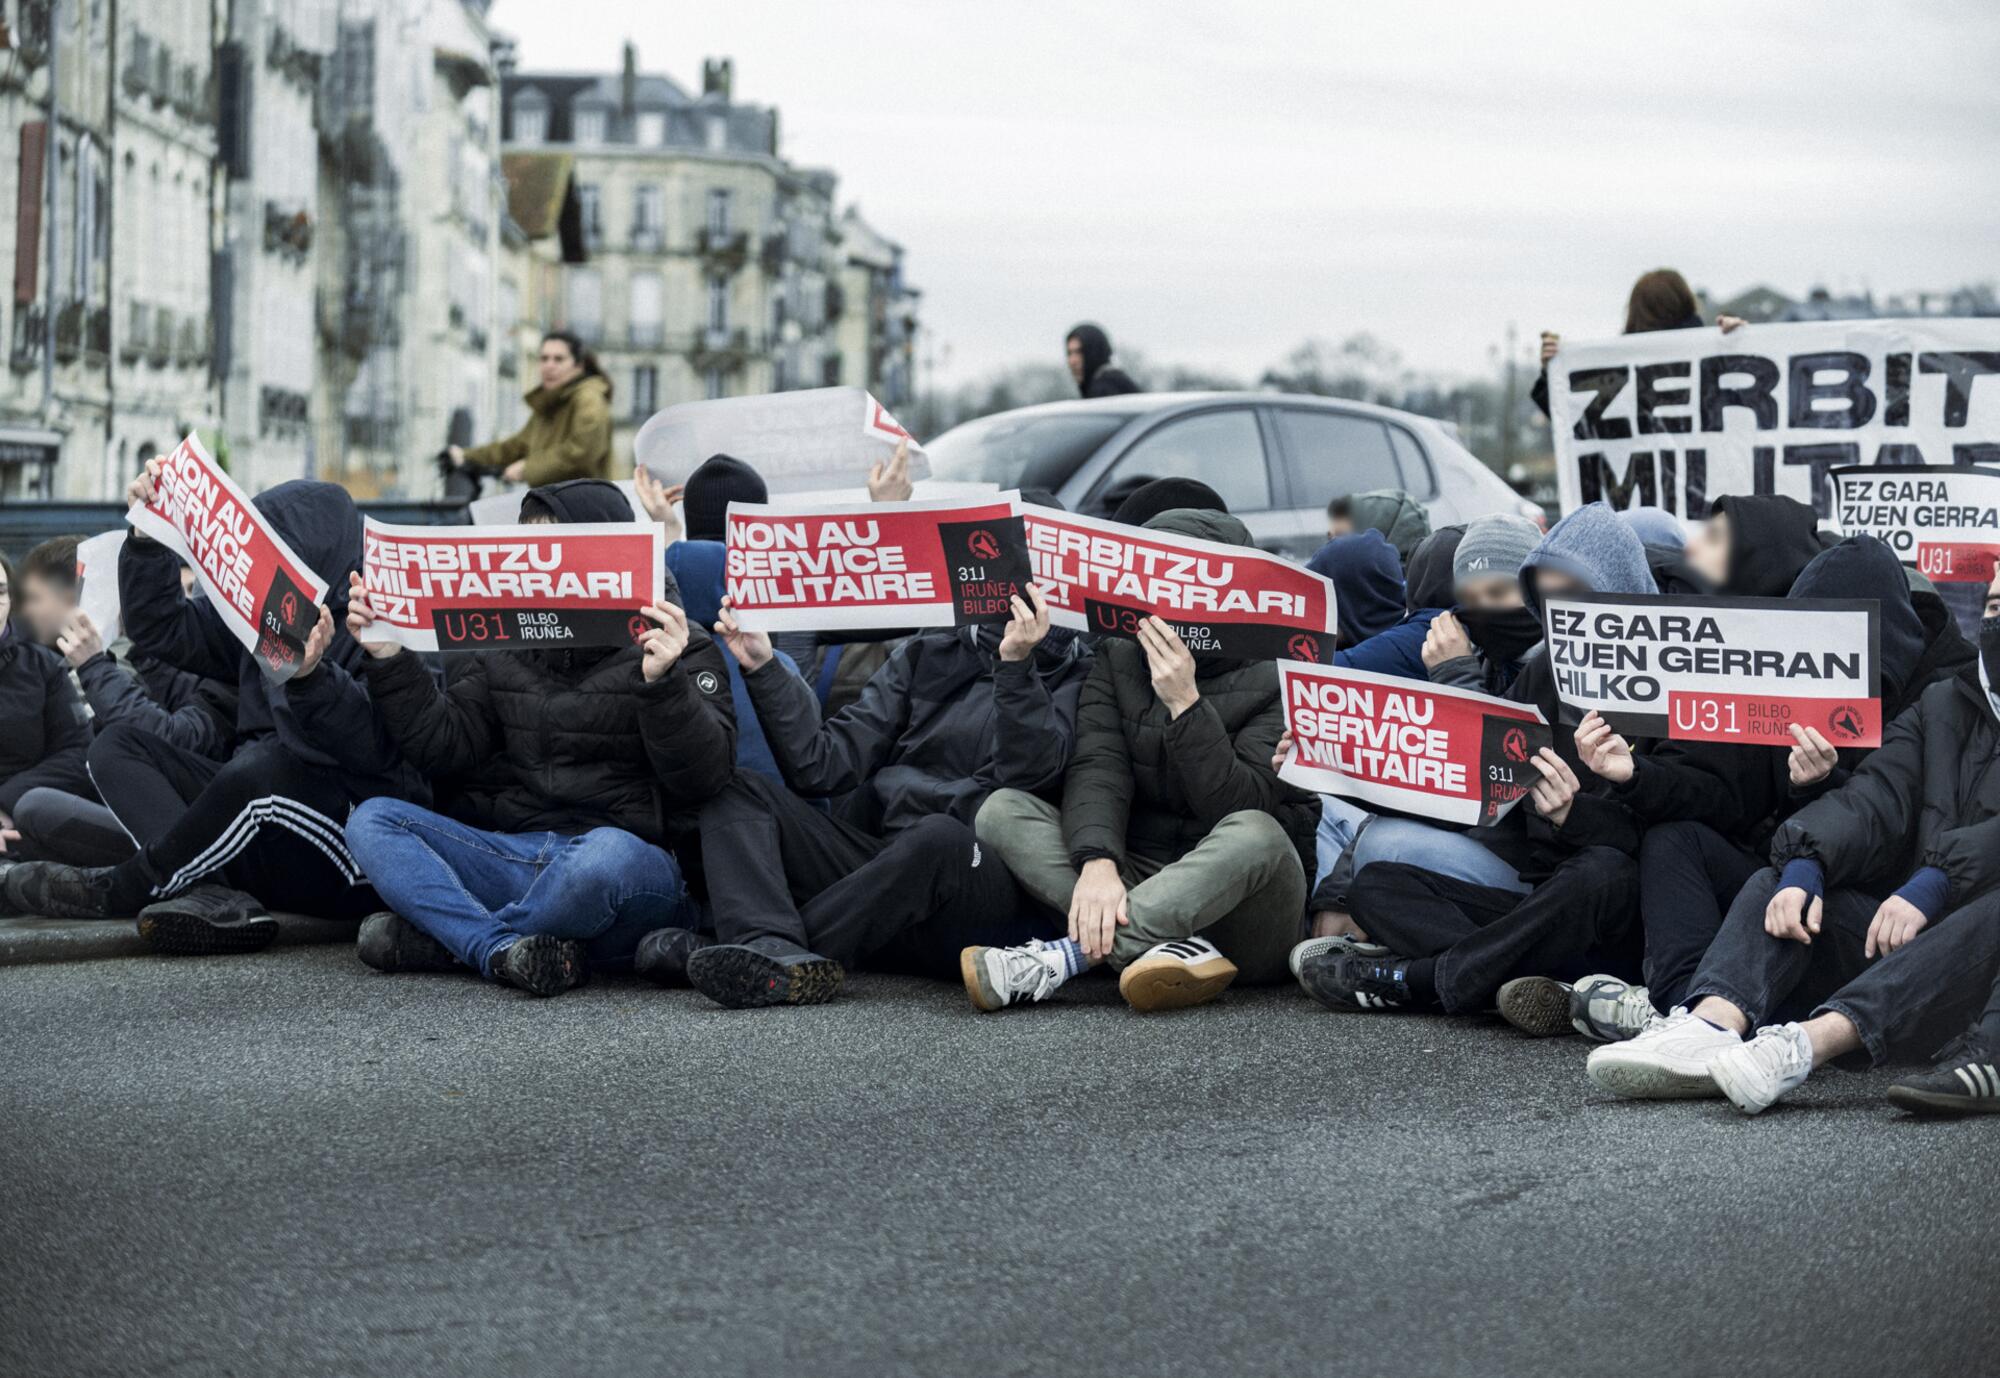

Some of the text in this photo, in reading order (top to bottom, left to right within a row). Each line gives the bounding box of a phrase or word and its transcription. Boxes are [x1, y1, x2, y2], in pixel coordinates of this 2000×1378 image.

[168, 443, 254, 545] NON AU
[1844, 481, 1949, 502] EZ GARA
[162, 463, 253, 580] SERVICE
[1842, 505, 1999, 529] ZUEN GERRA
[729, 520, 880, 549] NON AU
[156, 486, 255, 620] MILITAIRE
[366, 536, 562, 571] ZERBITZU
[728, 546, 907, 577] SERVICE
[1026, 521, 1233, 586] ERBITZU
[1920, 548, 1953, 574] U31
[366, 565, 632, 599] MILITARRARI
[727, 572, 936, 605] MILITAIRE
[961, 579, 1019, 598] IRUÑEA
[1034, 579, 1069, 606] Z!
[370, 595, 418, 624] EZ!
[517, 612, 558, 626] BILBO
[963, 599, 1009, 615] BILBO
[1097, 606, 1139, 634] U3
[445, 613, 510, 641] U31
[520, 622, 574, 640] IRUÑEA
[1550, 608, 1725, 643] EZ GARA
[1552, 639, 1860, 680] ZUEN GERRAN
[1556, 668, 1661, 702] HILKO
[1292, 679, 1434, 726] NON AU
[1675, 698, 1741, 733] U31
[1747, 703, 1791, 719] BILBO
[1295, 709, 1448, 760] SERVICE
[1747, 717, 1793, 736] IRUÑE
[1299, 737, 1467, 793] MILITAIRE
